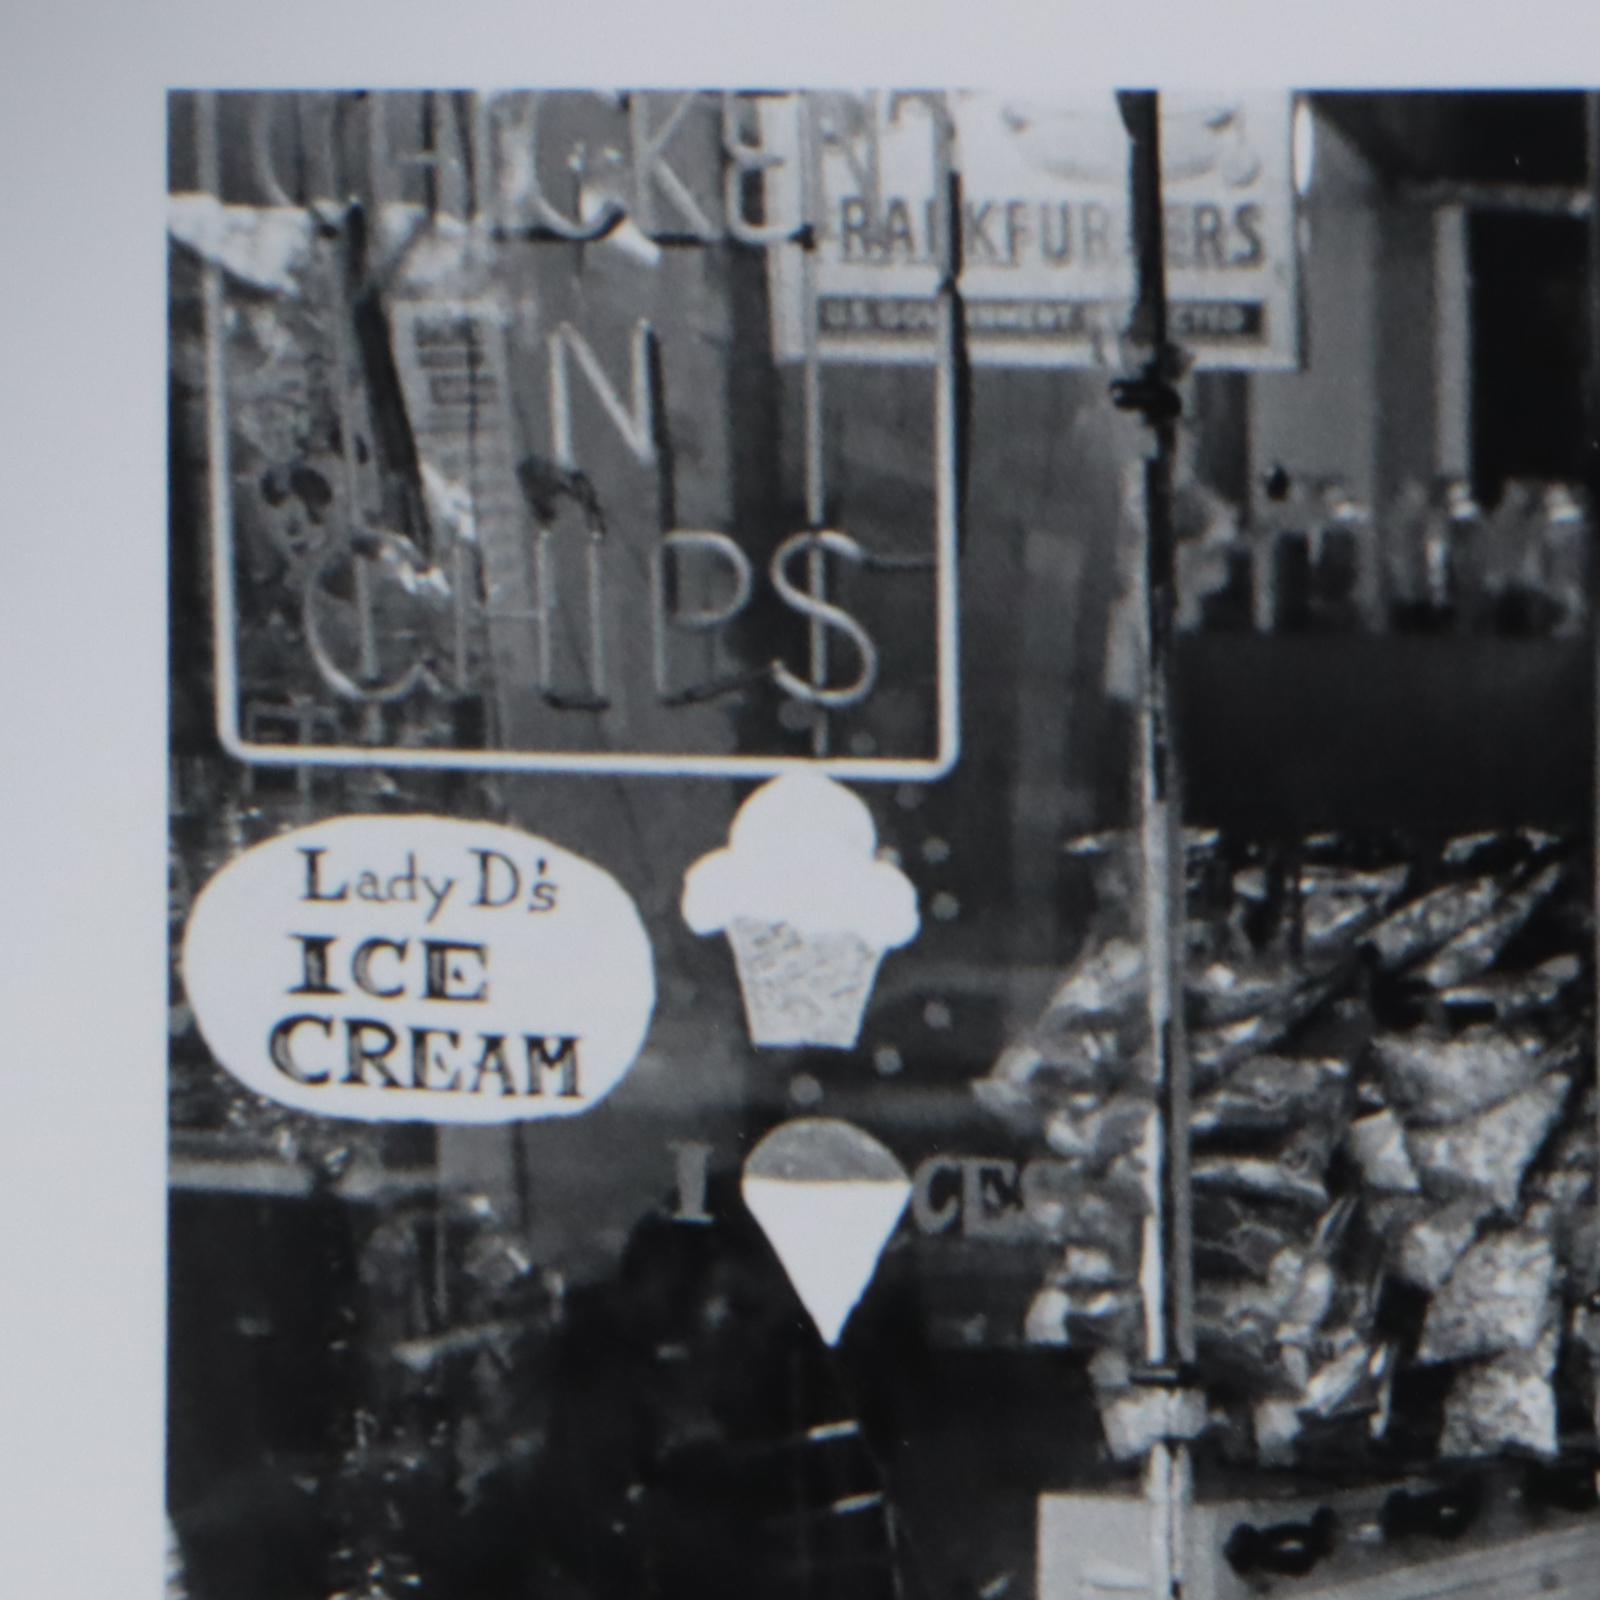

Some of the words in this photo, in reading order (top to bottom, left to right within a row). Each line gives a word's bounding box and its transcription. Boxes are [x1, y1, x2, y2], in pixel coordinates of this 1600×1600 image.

[303, 529, 876, 705] CHIPS
[296, 847, 454, 924] Lady
[466, 848, 559, 913] D's
[286, 932, 490, 1002] ICE
[266, 1013, 584, 1101] CREAM
